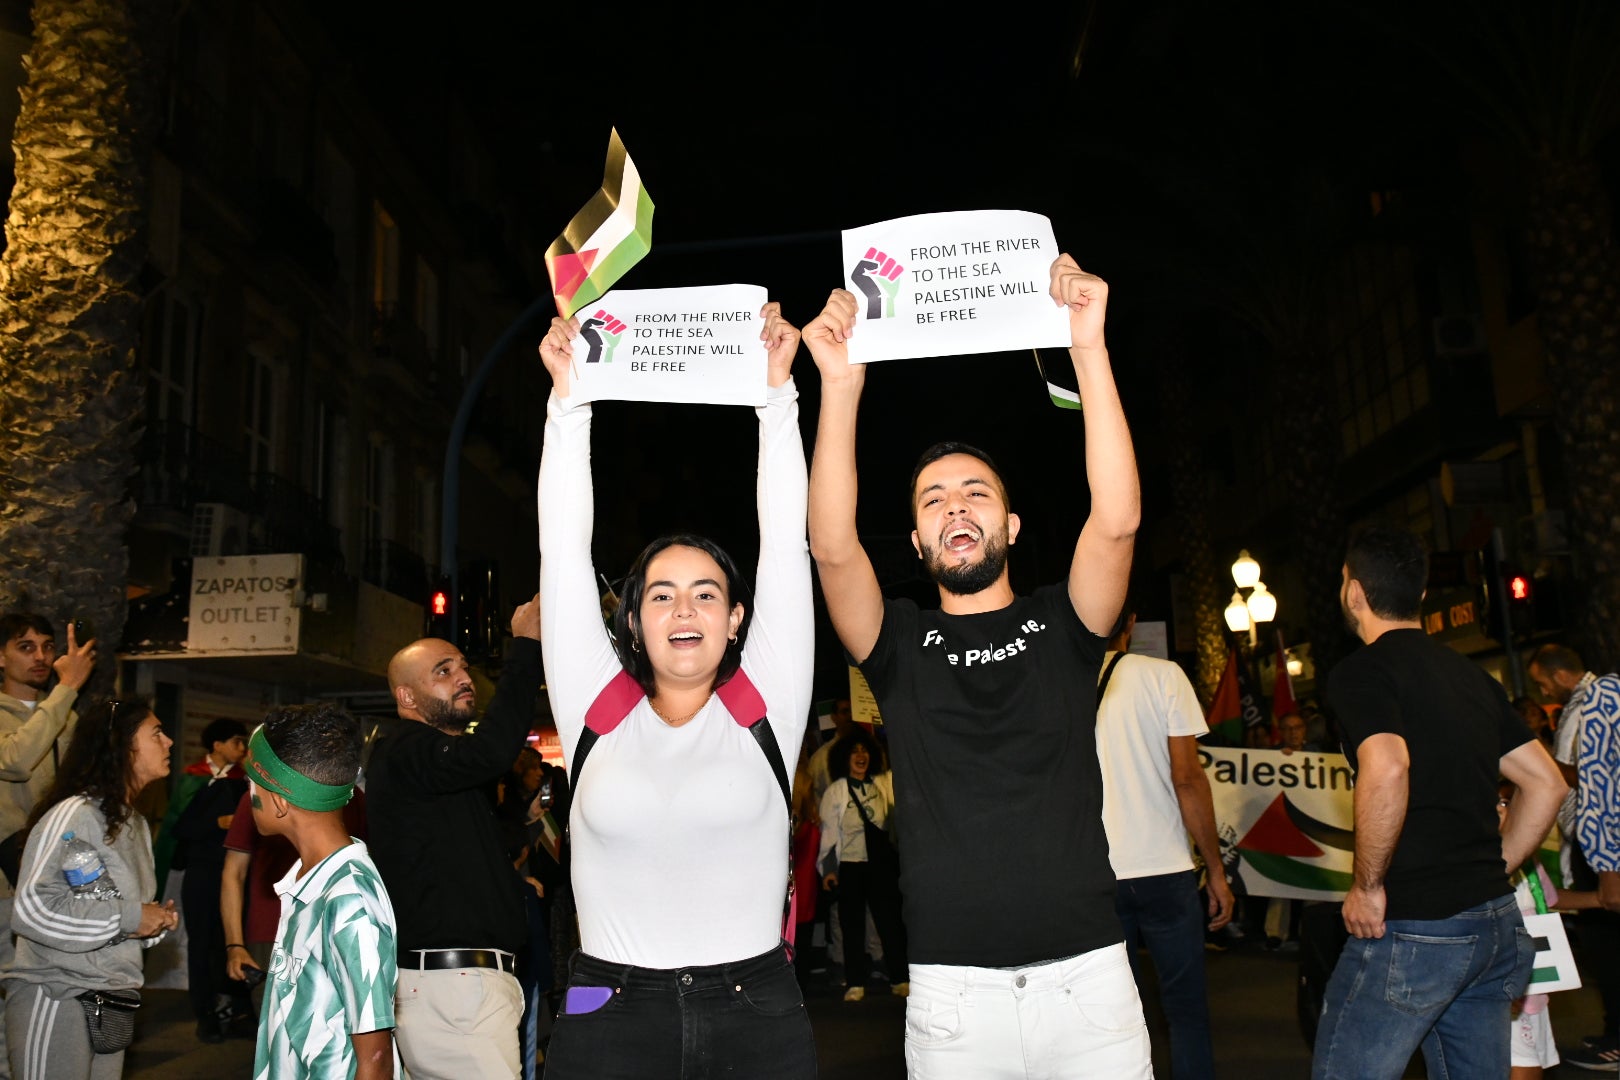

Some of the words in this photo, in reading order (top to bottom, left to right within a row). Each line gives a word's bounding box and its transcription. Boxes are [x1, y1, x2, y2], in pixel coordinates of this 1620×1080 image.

[909, 244, 957, 261] FROM
[961, 240, 992, 256] THE
[996, 238, 1041, 252] RIVER
[912, 268, 934, 283] TO
[938, 265, 968, 281] THE
[972, 261, 1002, 277] SEA
[914, 284, 996, 305] PALESTINE
[1000, 280, 1039, 296] WILL
[635, 313, 677, 323] FROM
[681, 312, 708, 322] THE
[712, 311, 752, 322] RIVER
[916, 312, 935, 325] BE
[940, 307, 977, 322] FREE
[633, 328, 653, 338] TO
[657, 328, 684, 338] THE
[687, 327, 714, 338] SEA
[632, 345, 706, 356] PALESTINE
[711, 344, 745, 355] WILL
[631, 361, 648, 372] BE
[652, 361, 687, 372] FREE
[195, 576, 286, 595] ZAPATOS
[201, 606, 281, 624] OUTLET
[1197, 750, 1357, 792] Palestin
